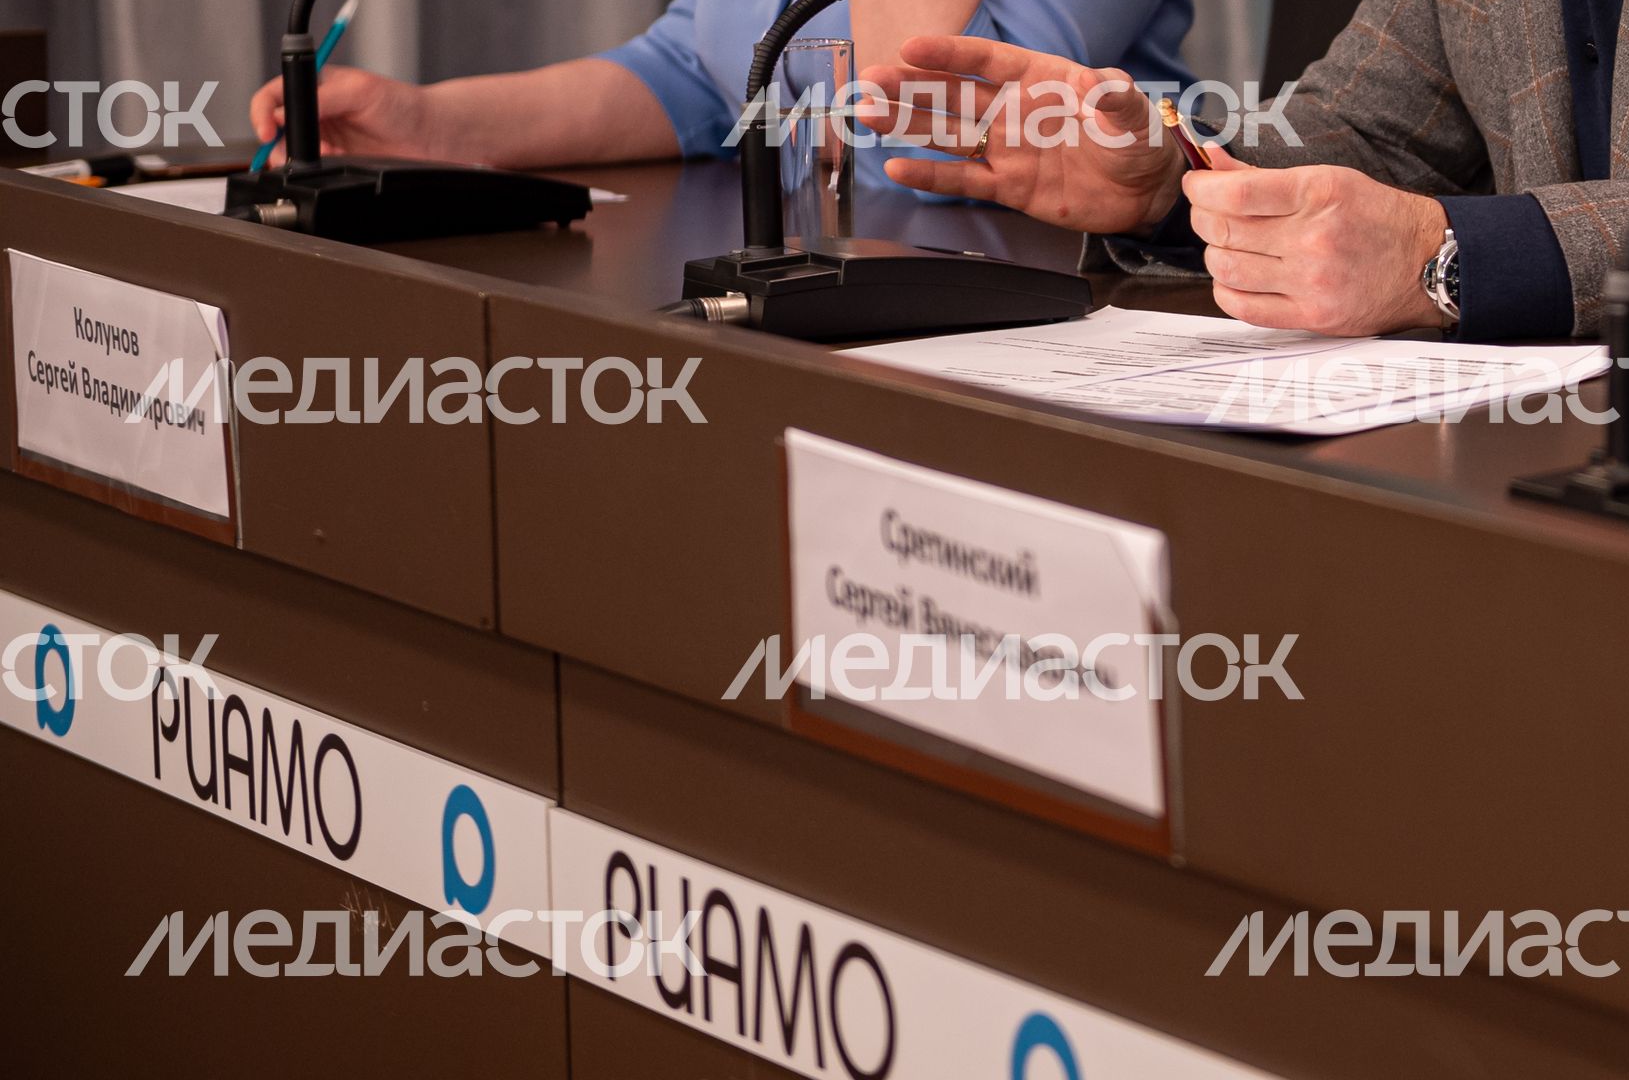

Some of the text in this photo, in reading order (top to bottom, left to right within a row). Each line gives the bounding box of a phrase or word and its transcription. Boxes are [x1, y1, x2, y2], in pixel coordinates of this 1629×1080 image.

[73, 306, 140, 357] Колунов
[27, 350, 206, 436] Сергей Владимирович
[825, 564, 914, 630] Сергей
